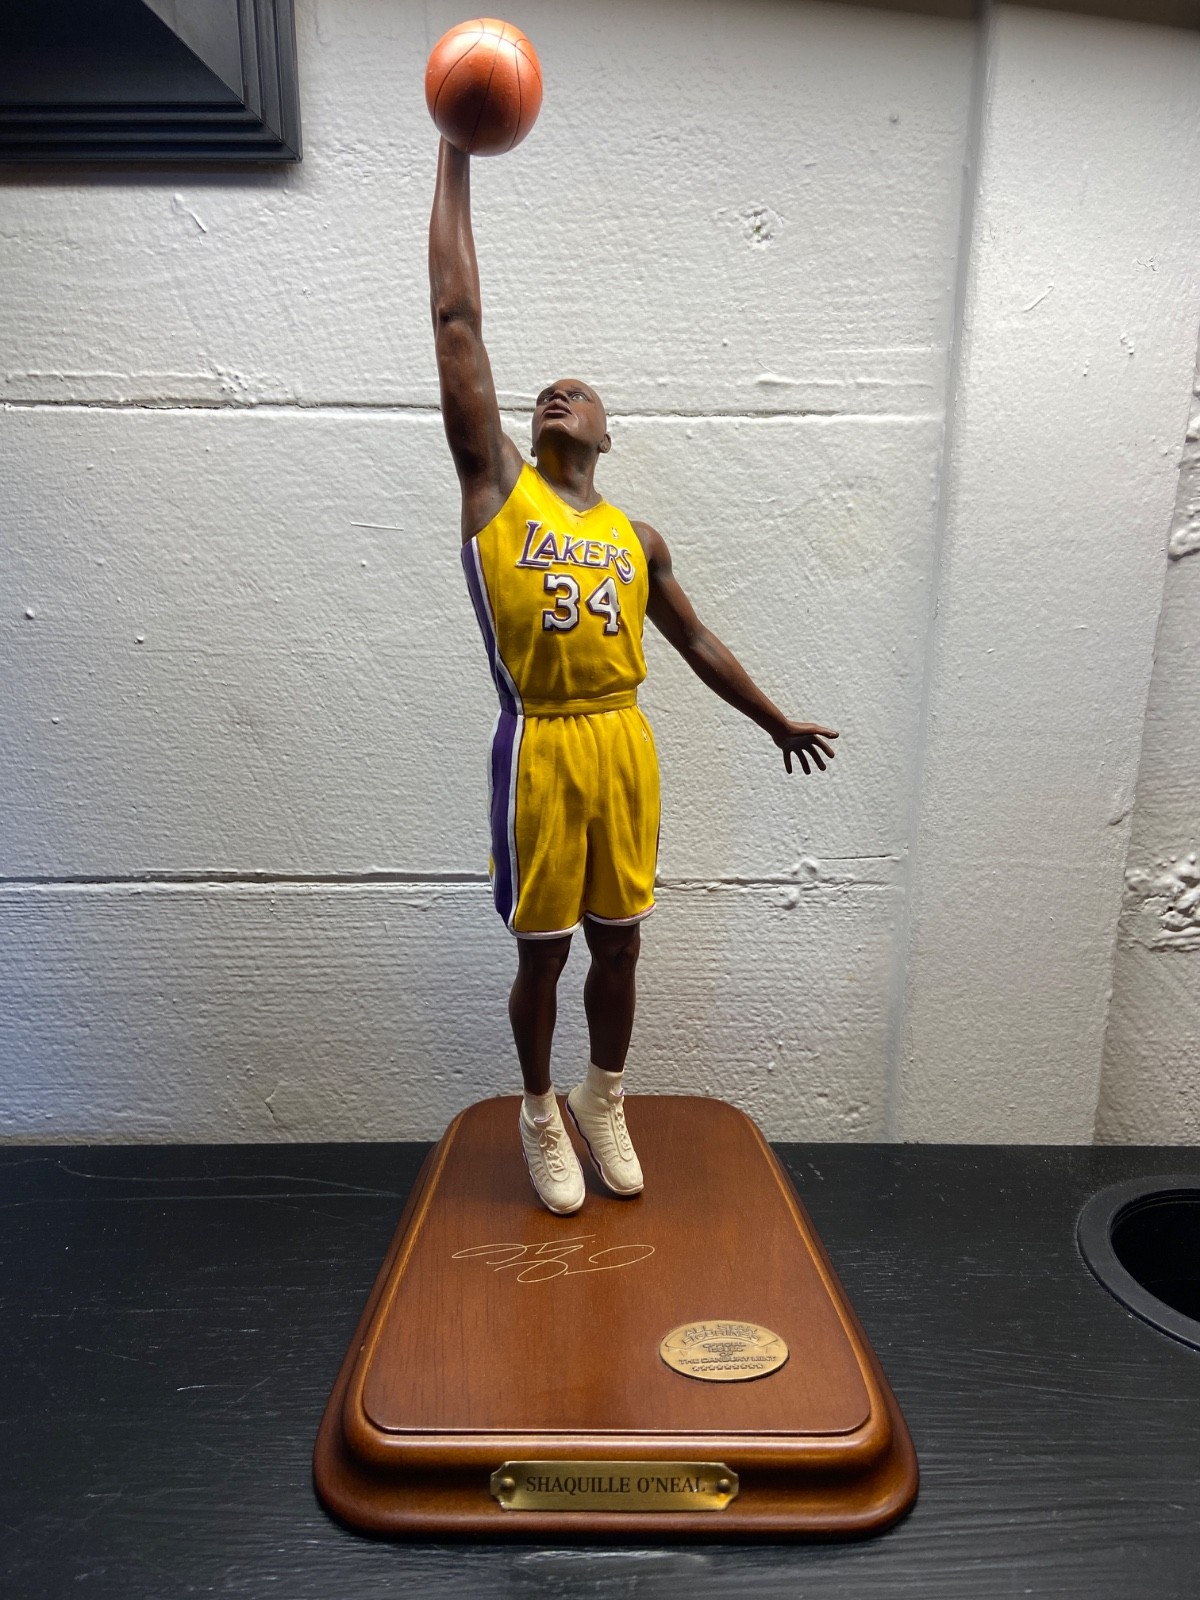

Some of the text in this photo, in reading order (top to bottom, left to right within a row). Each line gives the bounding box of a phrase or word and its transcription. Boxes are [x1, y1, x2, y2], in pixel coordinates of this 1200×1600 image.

[515, 520, 636, 584] LAKERS
[542, 572, 621, 636] 34
[685, 1325, 712, 1337] ALL
[526, 1476, 706, 1495] SHAQUILLE O'NEAL
